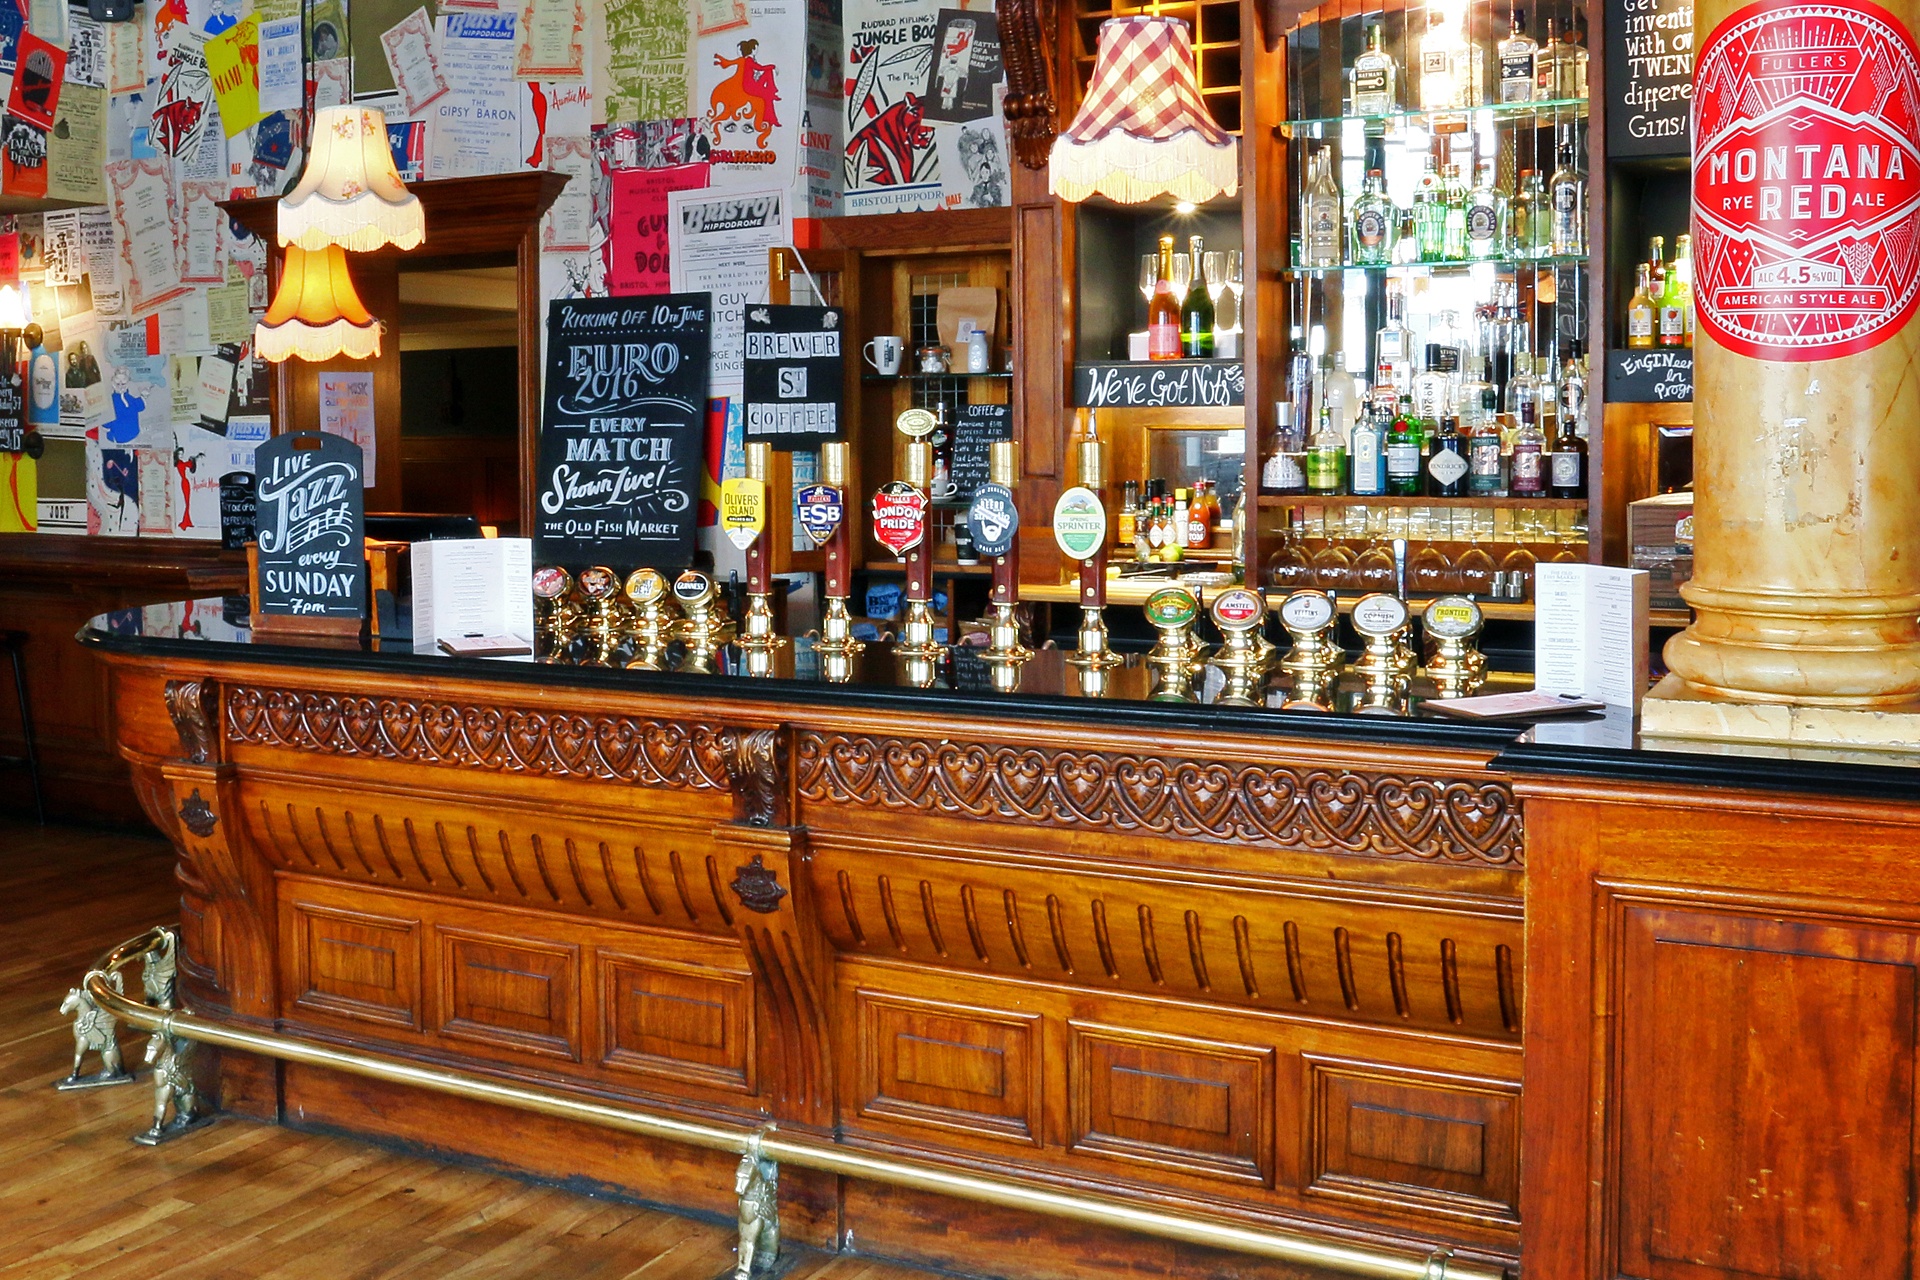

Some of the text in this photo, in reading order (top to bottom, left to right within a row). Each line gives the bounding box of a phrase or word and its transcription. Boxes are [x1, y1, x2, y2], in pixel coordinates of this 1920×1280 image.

[861, 14, 936, 31] RUDYARD KIPLING'S
[462, 30, 512, 38] HIPPODROME
[851, 28, 907, 49] JUNGLE
[972, 39, 1001, 49] RATTLE
[1625, 31, 1666, 57] With
[172, 47, 200, 67] JUNGLE
[970, 60, 986, 69] MAN
[971, 52, 1000, 62] SIMPLE
[1429, 58, 1441, 67] 24
[1628, 52, 1693, 79] TWEN
[1761, 53, 1848, 71] FULLER'S
[471, 99, 487, 108] THE
[1624, 81, 1693, 112] differe
[440, 105, 517, 121] GIPSY BARON
[1628, 115, 1687, 138] Gins!
[11, 151, 39, 168] DEVIL
[1709, 144, 1906, 186] MONTANA
[852, 196, 892, 208] BRISTOL
[1722, 184, 1886, 221] RYE RED ALE
[683, 195, 781, 235] BRISTOL
[703, 218, 763, 231] HIPPODROME
[1758, 269, 1774, 283] ALC
[1776, 266, 1811, 285] 4.5
[620, 281, 649, 289] BRISTOL
[718, 292, 749, 306] GUY
[1723, 293, 1877, 306] AMERICAN STYLE ALE
[561, 305, 618, 329] KICKING
[621, 310, 647, 326] OFF
[673, 305, 705, 329] JUNE
[712, 309, 745, 323] ITCH
[748, 334, 839, 357] BREWER
[567, 342, 680, 386] EURO
[1664, 368, 1687, 383] In
[575, 367, 639, 402] 2016
[1087, 367, 1146, 407] We've
[1148, 369, 1188, 407] Got
[1190, 364, 1230, 407] Nuts
[968, 404, 995, 417] COFFEE
[589, 417, 647, 434] EVERY
[565, 437, 673, 462] MATCH
[272, 452, 312, 485] LIVE
[541, 463, 667, 514] Shown Live!
[258, 463, 354, 554] Jazz
[728, 506, 755, 516] ISLAND
[799, 504, 841, 525] ESB
[872, 505, 925, 521] LONDON
[543, 519, 679, 536] THE OLD FISH MARKET
[880, 518, 916, 530] PRIDE
[1056, 522, 1102, 530] SPRINTER
[1188, 523, 1205, 532] BIG
[1188, 533, 1205, 541] TOM
[298, 550, 341, 569] every
[265, 569, 356, 598] SUNDAY
[676, 581, 705, 591] GUINNESS
[290, 597, 326, 615] 7pm
[1436, 608, 1469, 617] FRONTIER
